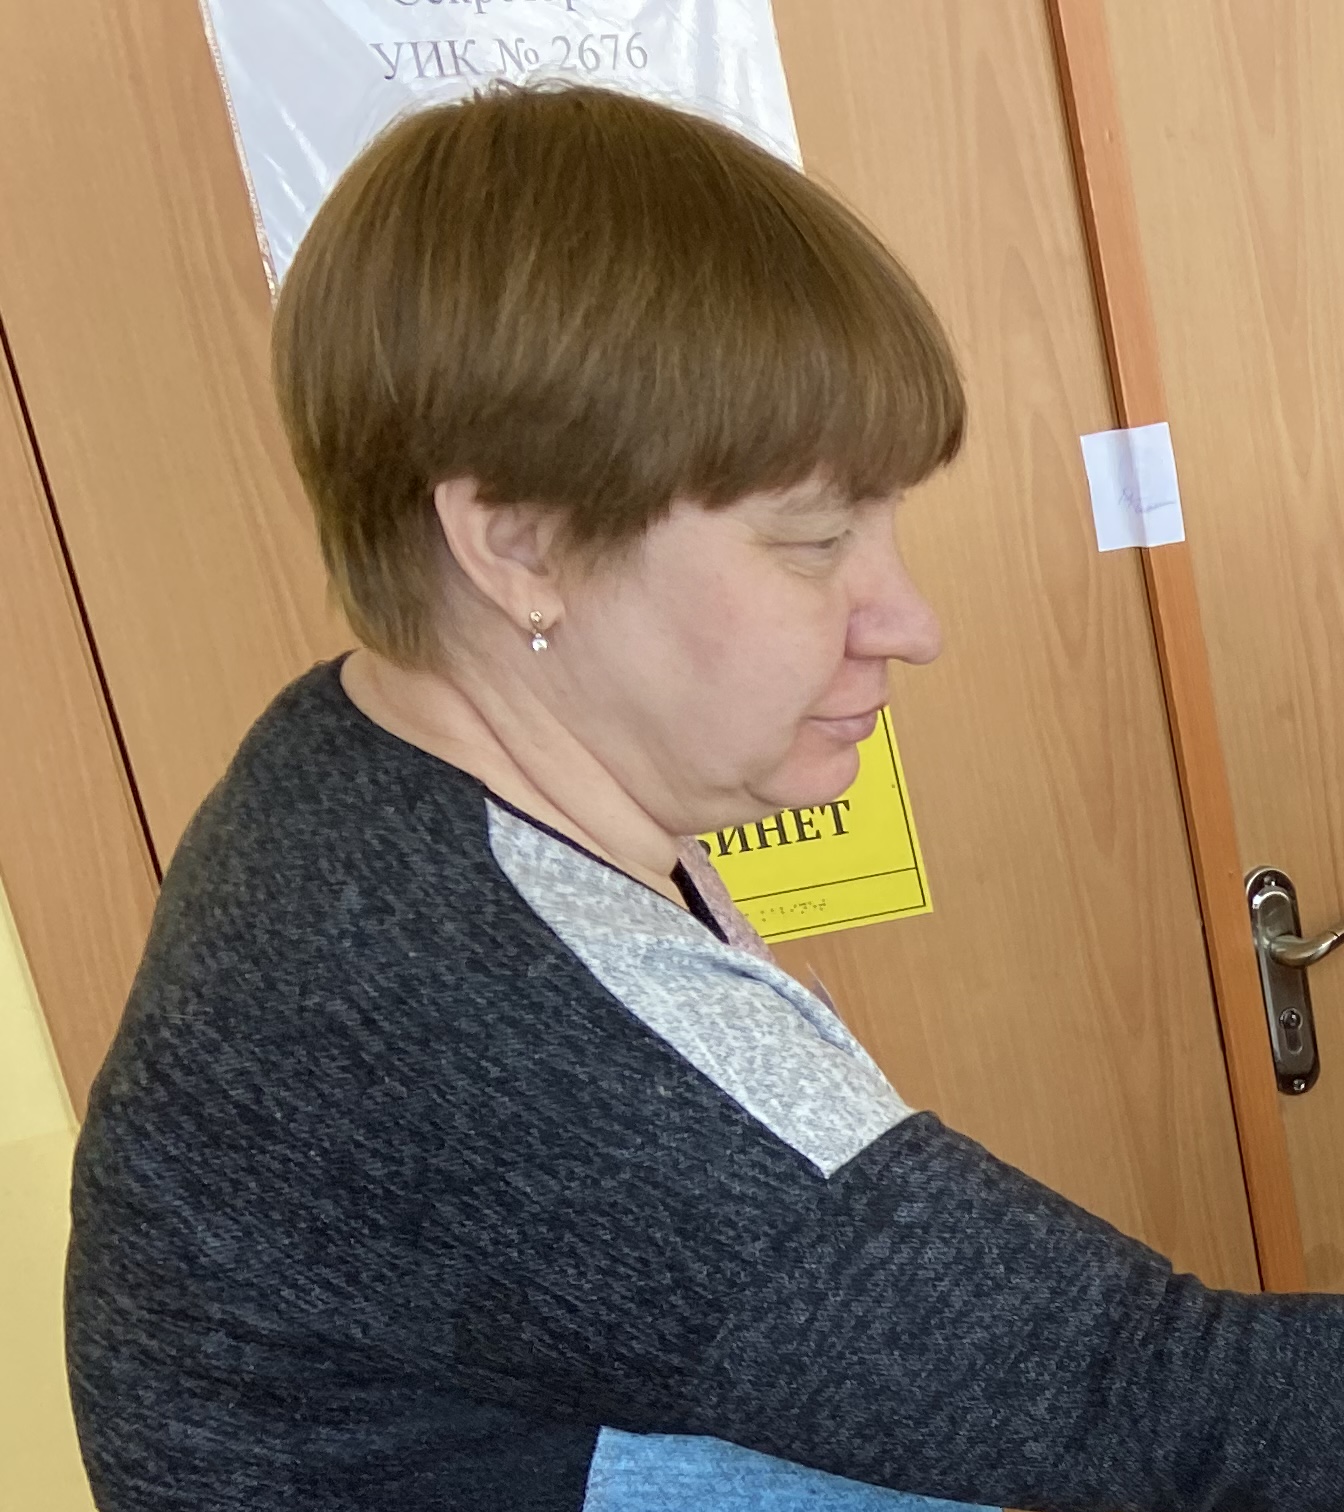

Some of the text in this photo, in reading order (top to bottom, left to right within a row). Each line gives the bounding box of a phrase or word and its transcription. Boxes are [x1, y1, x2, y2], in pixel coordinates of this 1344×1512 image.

[370, 32, 649, 80] УИК № 2676
[697, 799, 851, 857] ИНЕТ
